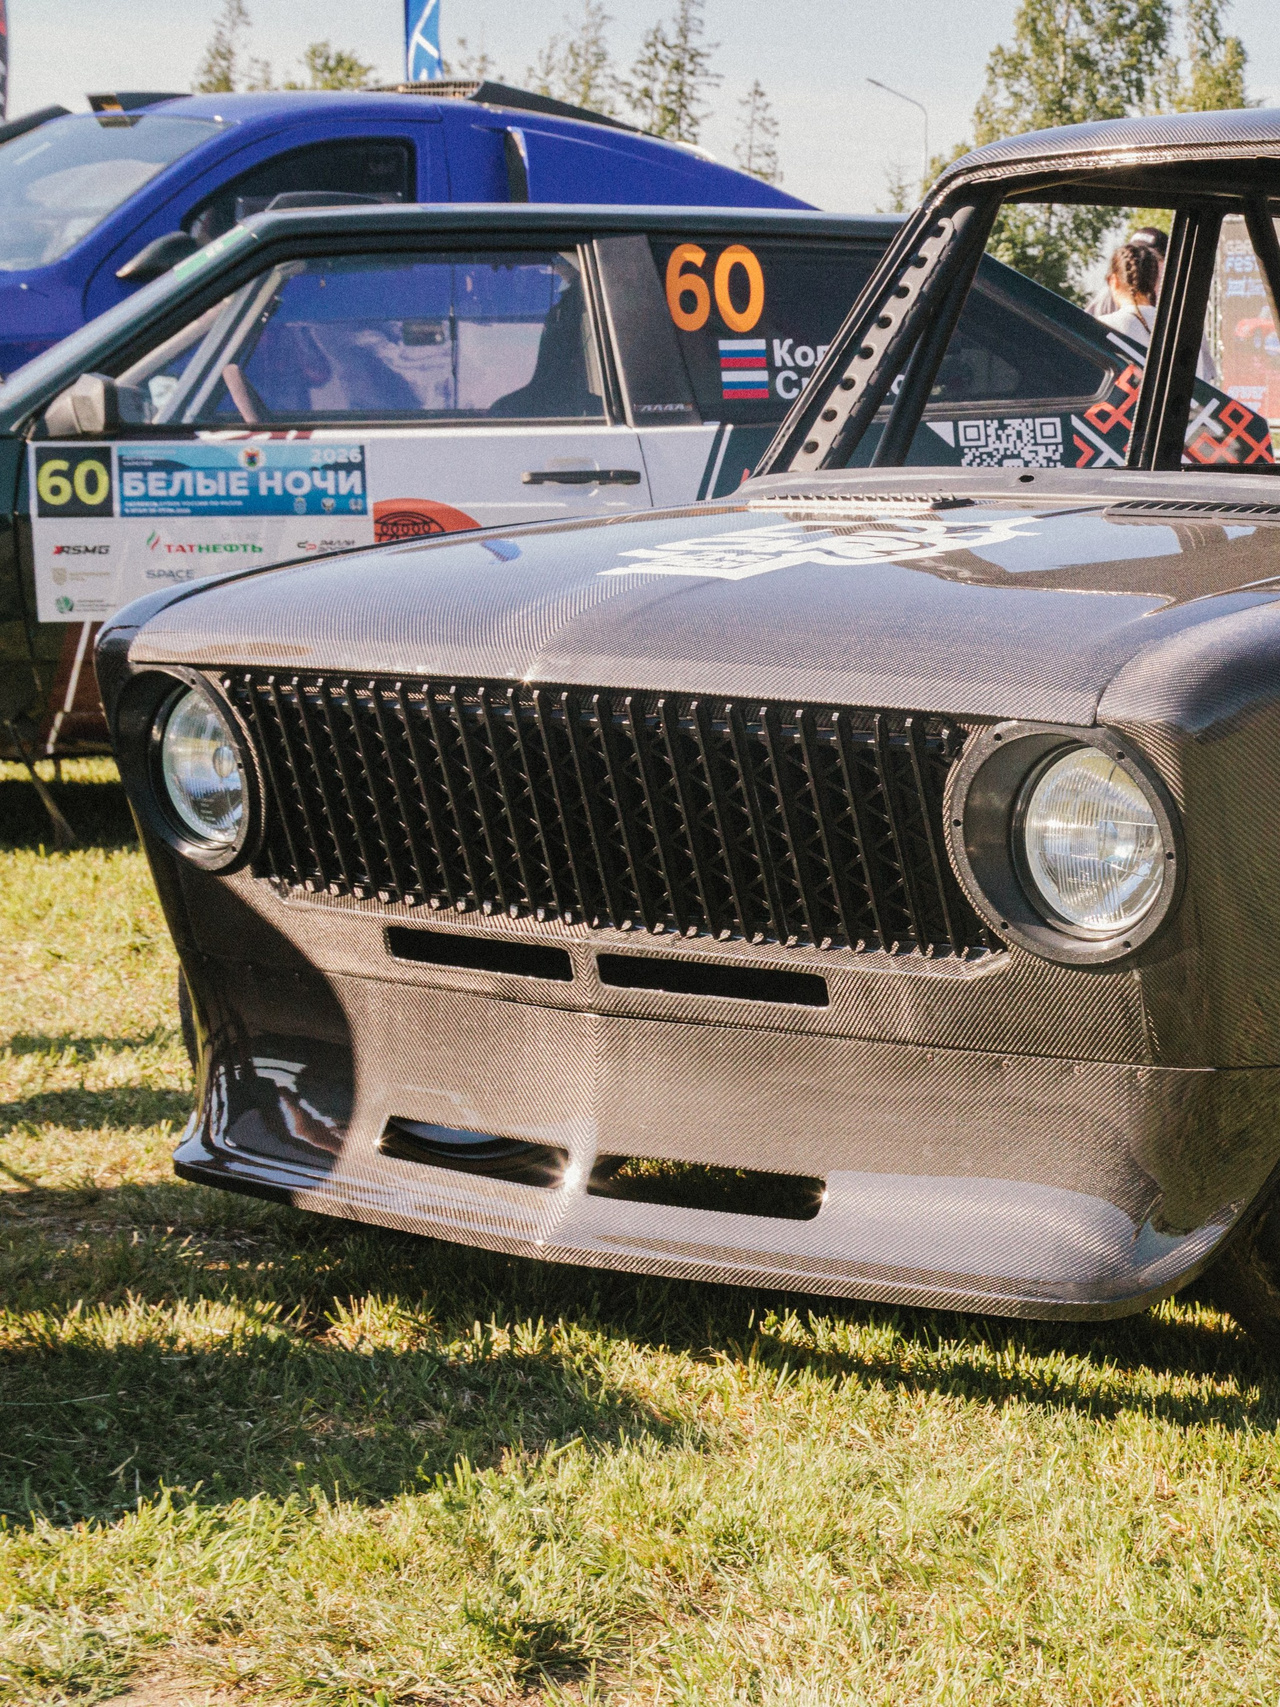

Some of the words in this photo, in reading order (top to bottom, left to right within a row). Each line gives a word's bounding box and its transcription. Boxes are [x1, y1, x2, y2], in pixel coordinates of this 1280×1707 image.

[666, 243, 765, 332] 60
[310, 448, 362, 464] 2026
[37, 459, 110, 505] 60
[122, 470, 250, 497] БЕЛЫЕ
[258, 469, 362, 496] НОЧИ
[164, 543, 263, 554] ТАТНЕФТЬ
[146, 569, 196, 579] SPACE
